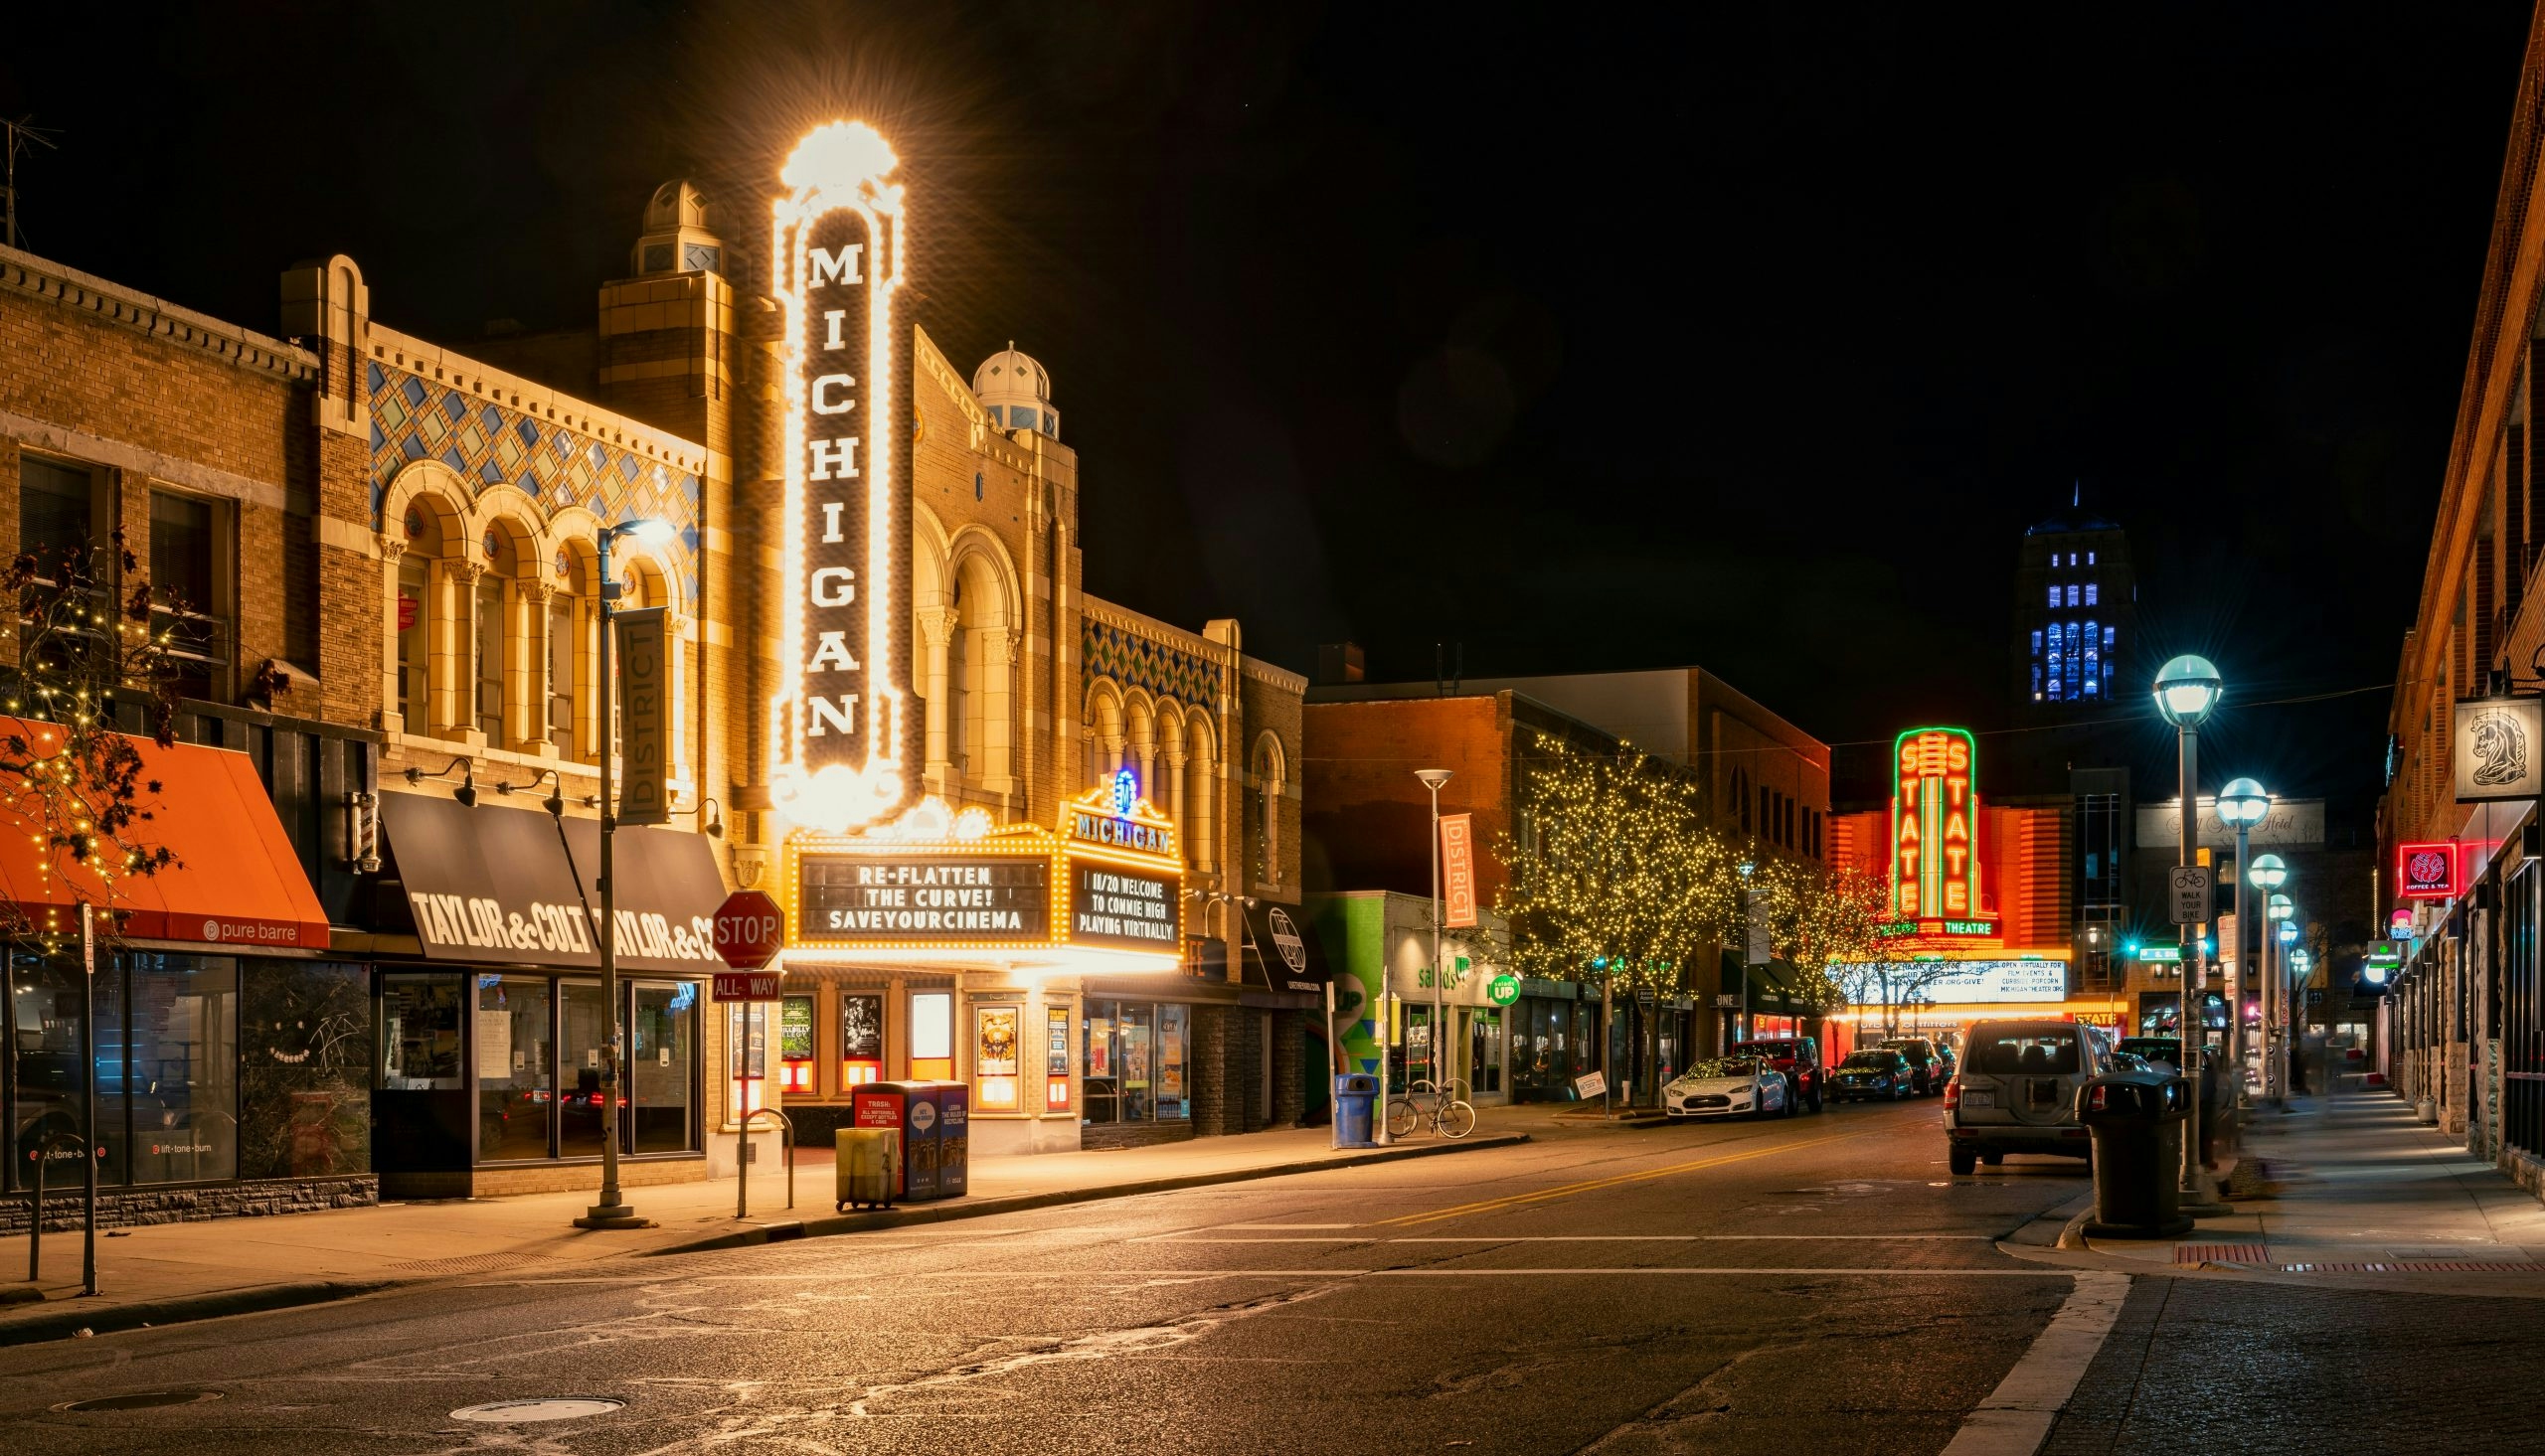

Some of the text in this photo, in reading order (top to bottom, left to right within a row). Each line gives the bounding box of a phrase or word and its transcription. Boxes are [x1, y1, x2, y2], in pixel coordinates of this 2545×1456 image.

[806, 243, 863, 737] MICHIGAN
[629, 630, 654, 804] DISTRICT
[1076, 813, 1169, 854] MICHIGAN
[1900, 744, 1919, 911] STATE
[1946, 742, 1968, 911] STATE
[2255, 811, 2293, 833] Hotel
[860, 867, 990, 886] RE-FLATTEN
[1448, 826, 1468, 916] DISTRICT
[867, 889, 993, 907] THE CURVE!
[1093, 873, 1162, 899] 11/20 WELCOME
[1093, 894, 1166, 920] TO COMMIE HIGH
[2180, 900, 2201, 909] YOUR
[2182, 910, 2200, 919] BIKE
[222, 923, 255, 941] pure
[258, 922, 296, 940] barre
[717, 915, 775, 945] STOP
[829, 910, 1022, 930] SAVEYOURCINEMA
[1080, 912, 1173, 942] PLAYING VIRTUALLY
[1945, 921, 1992, 935] THEATRE
[716, 978, 775, 996] ALL WAY
[1418, 962, 1456, 990] salds
[1494, 986, 1515, 999] UP
[2076, 1013, 2117, 1025] STATE
